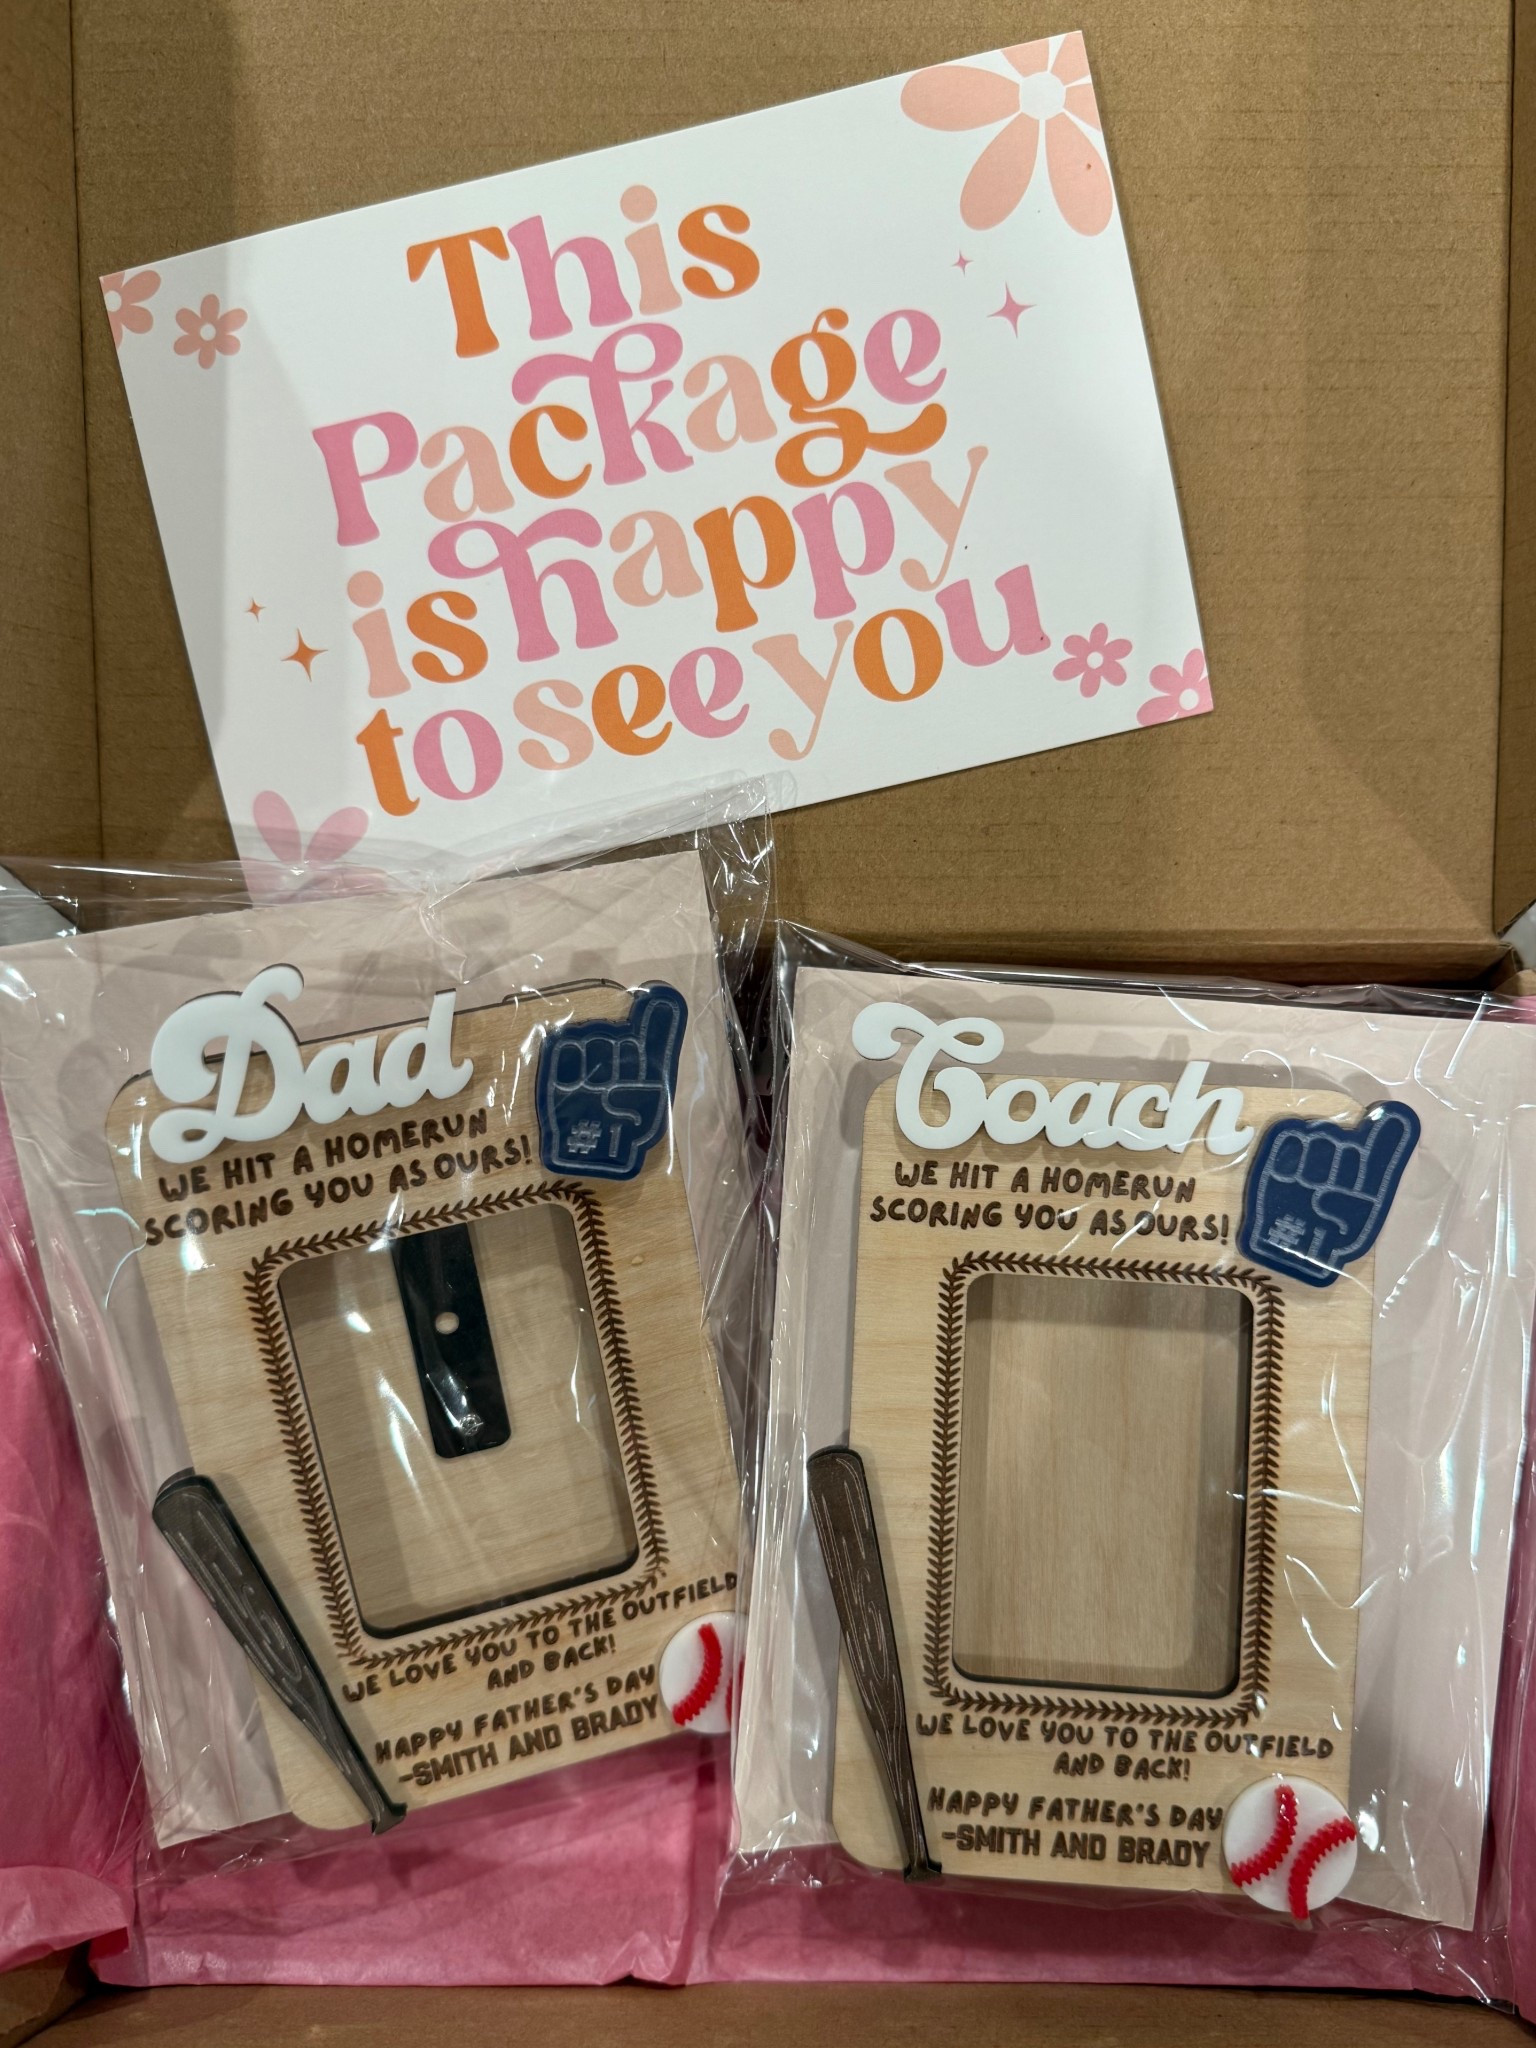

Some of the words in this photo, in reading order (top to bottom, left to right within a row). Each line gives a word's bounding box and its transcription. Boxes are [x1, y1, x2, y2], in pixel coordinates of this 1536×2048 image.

[406, 184, 760, 359] This
[312, 307, 947, 547] Package
[347, 571, 488, 698] is
[427, 445, 988, 662] happy
[356, 709, 503, 817] to
[752, 564, 1050, 761] you
[149, 963, 474, 1163] Dad
[852, 1002, 1254, 1155] Coach
[145, 1188, 294, 1246] SCORING
[305, 1174, 374, 1210] YOU
[389, 1161, 428, 1192] AS
[434, 1134, 531, 1179] OURS!
[159, 1165, 207, 1202] WE
[223, 1151, 275, 1190] HIT
[293, 1145, 314, 1175] A
[325, 1108, 488, 1169] HOMERUN
[895, 1161, 938, 1187] WE
[949, 1163, 998, 1190] HIT
[1011, 1167, 1030, 1193] A
[1042, 1167, 1195, 1203] HOMERUN
[870, 1197, 1002, 1229] SCORING
[1015, 1204, 1077, 1231] YOU
[1089, 1208, 1126, 1236] AS
[1135, 1212, 1229, 1244] OURS!
[342, 1674, 381, 1701] WE
[389, 1656, 457, 1687] LOVE
[465, 1637, 517, 1669] YOU
[526, 1625, 559, 1650] TO
[568, 1605, 616, 1637] THE
[621, 1572, 737, 1620] OUTFIELD
[487, 1661, 534, 1690] AND
[543, 1634, 616, 1671] BACK!
[376, 1720, 462, 1764] HAPPY
[474, 1680, 599, 1736] FATHER'S
[607, 1664, 655, 1696] DAY
[398, 1740, 499, 1787] -SMITH
[509, 1726, 562, 1760] AND
[571, 1694, 659, 1742] BRADY
[916, 1713, 952, 1736] WE
[963, 1715, 1030, 1741] LOVE
[1040, 1721, 1093, 1745] YOU
[1104, 1726, 1138, 1749] TO
[1151, 1729, 1196, 1753] THE
[1204, 1732, 1333, 1759] OUTFIELD
[927, 1787, 1018, 1816] HAPPY
[1029, 1796, 1160, 1828] FATHER'S
[1169, 1806, 1223, 1832] DAY
[1053, 1752, 1104, 1775] AND
[1114, 1753, 1190, 1780] BACK!
[942, 1824, 1040, 1855] -SMITH
[1051, 1831, 1106, 1861] AND
[1117, 1836, 1211, 1868] BRADY
